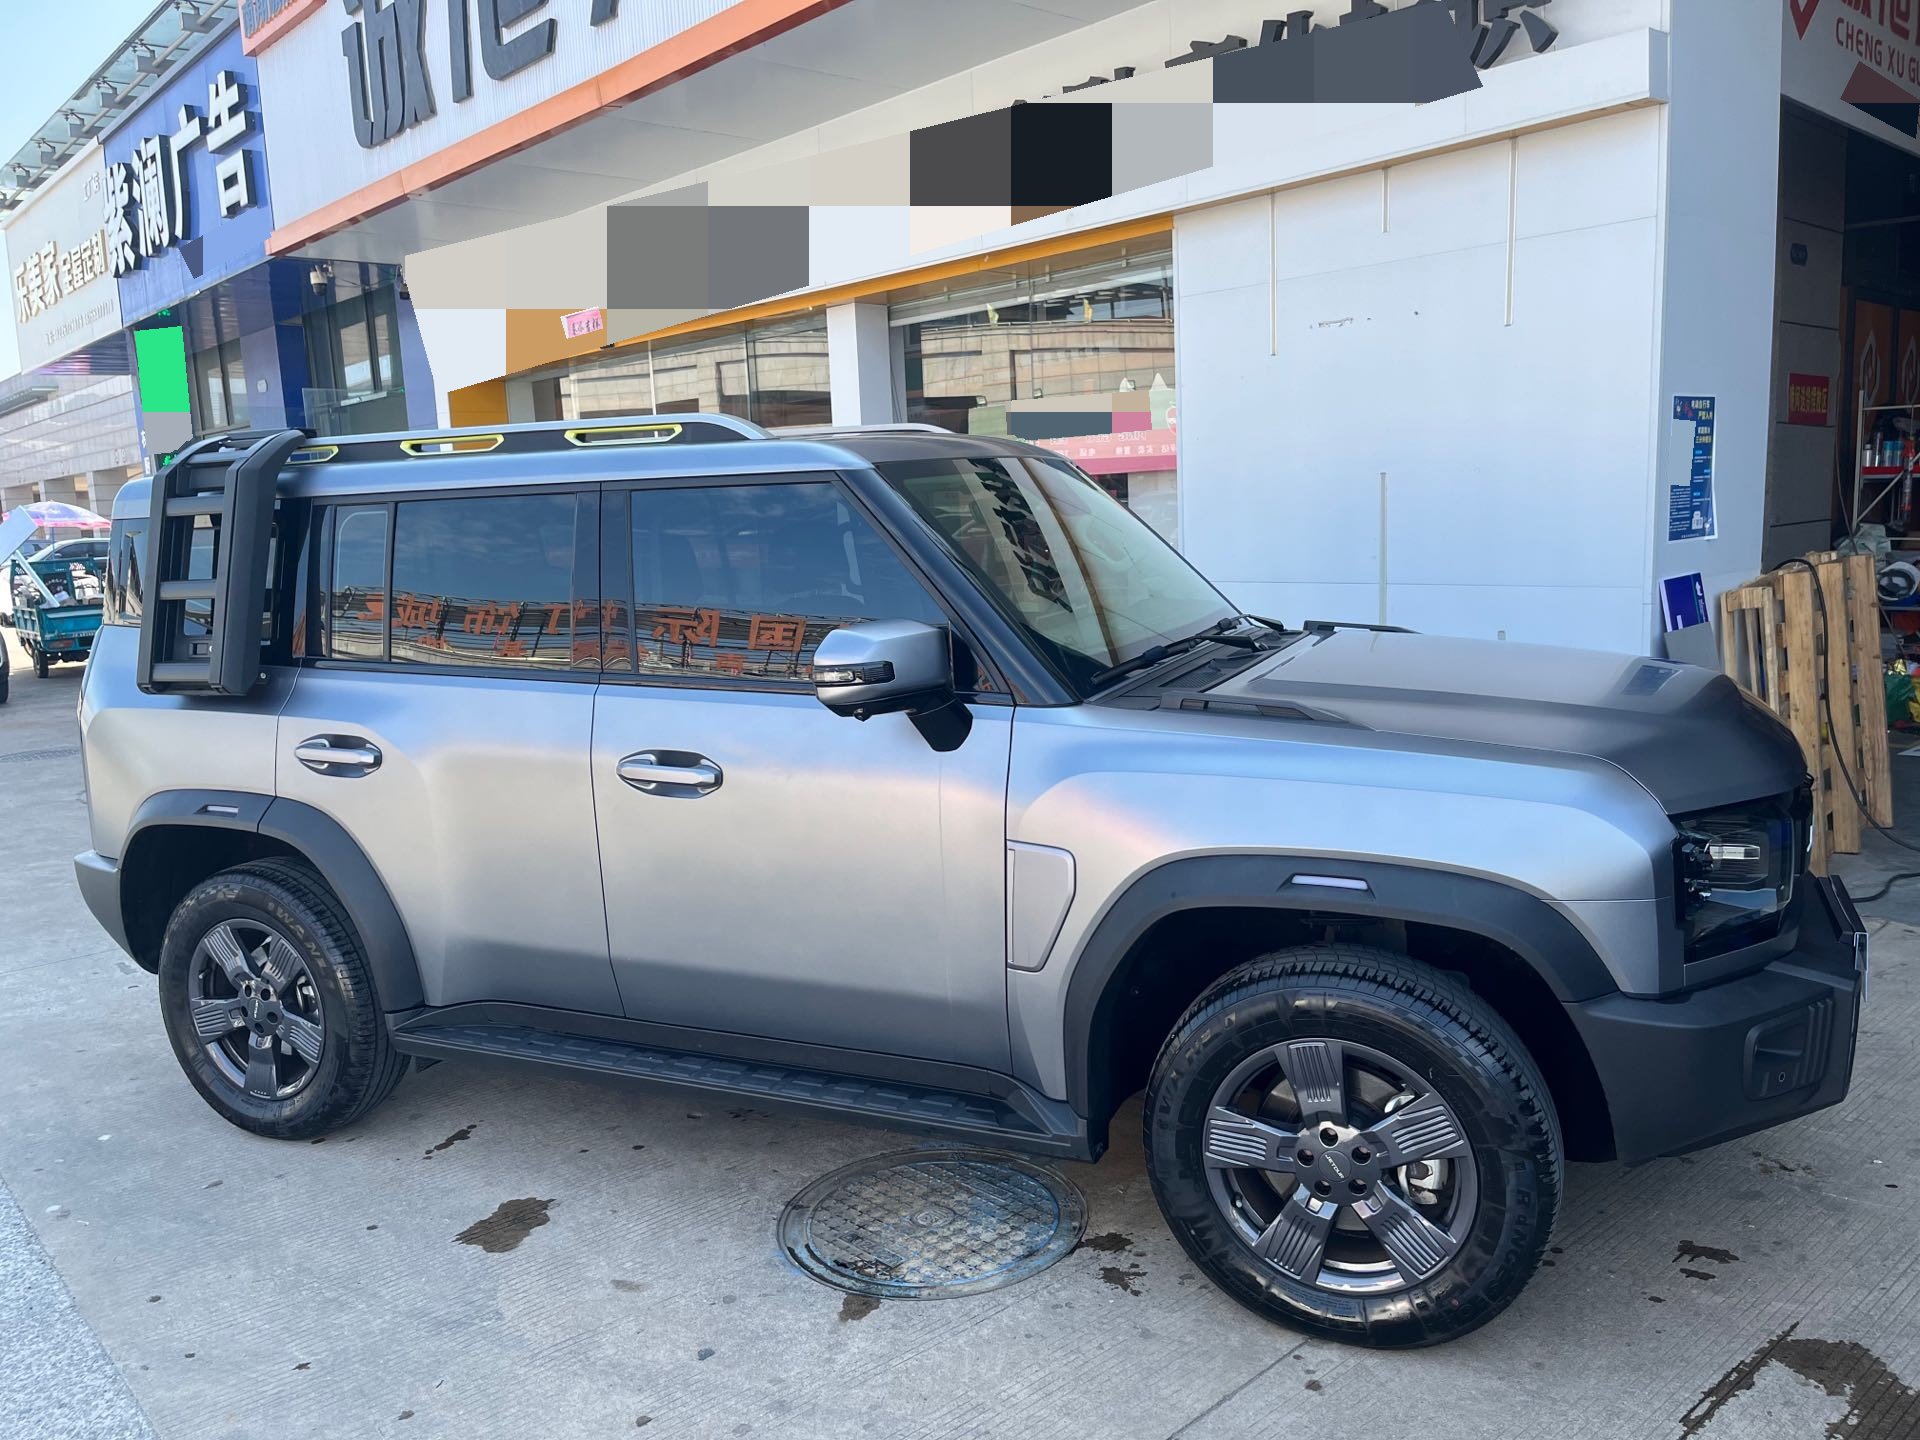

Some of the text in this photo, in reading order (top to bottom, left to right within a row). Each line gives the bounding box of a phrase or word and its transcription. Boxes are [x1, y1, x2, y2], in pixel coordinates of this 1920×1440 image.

[1836, 17, 1882, 67] CHENG
[1887, 45, 1905, 78] XU
[15, 240, 62, 323] 乐美家
